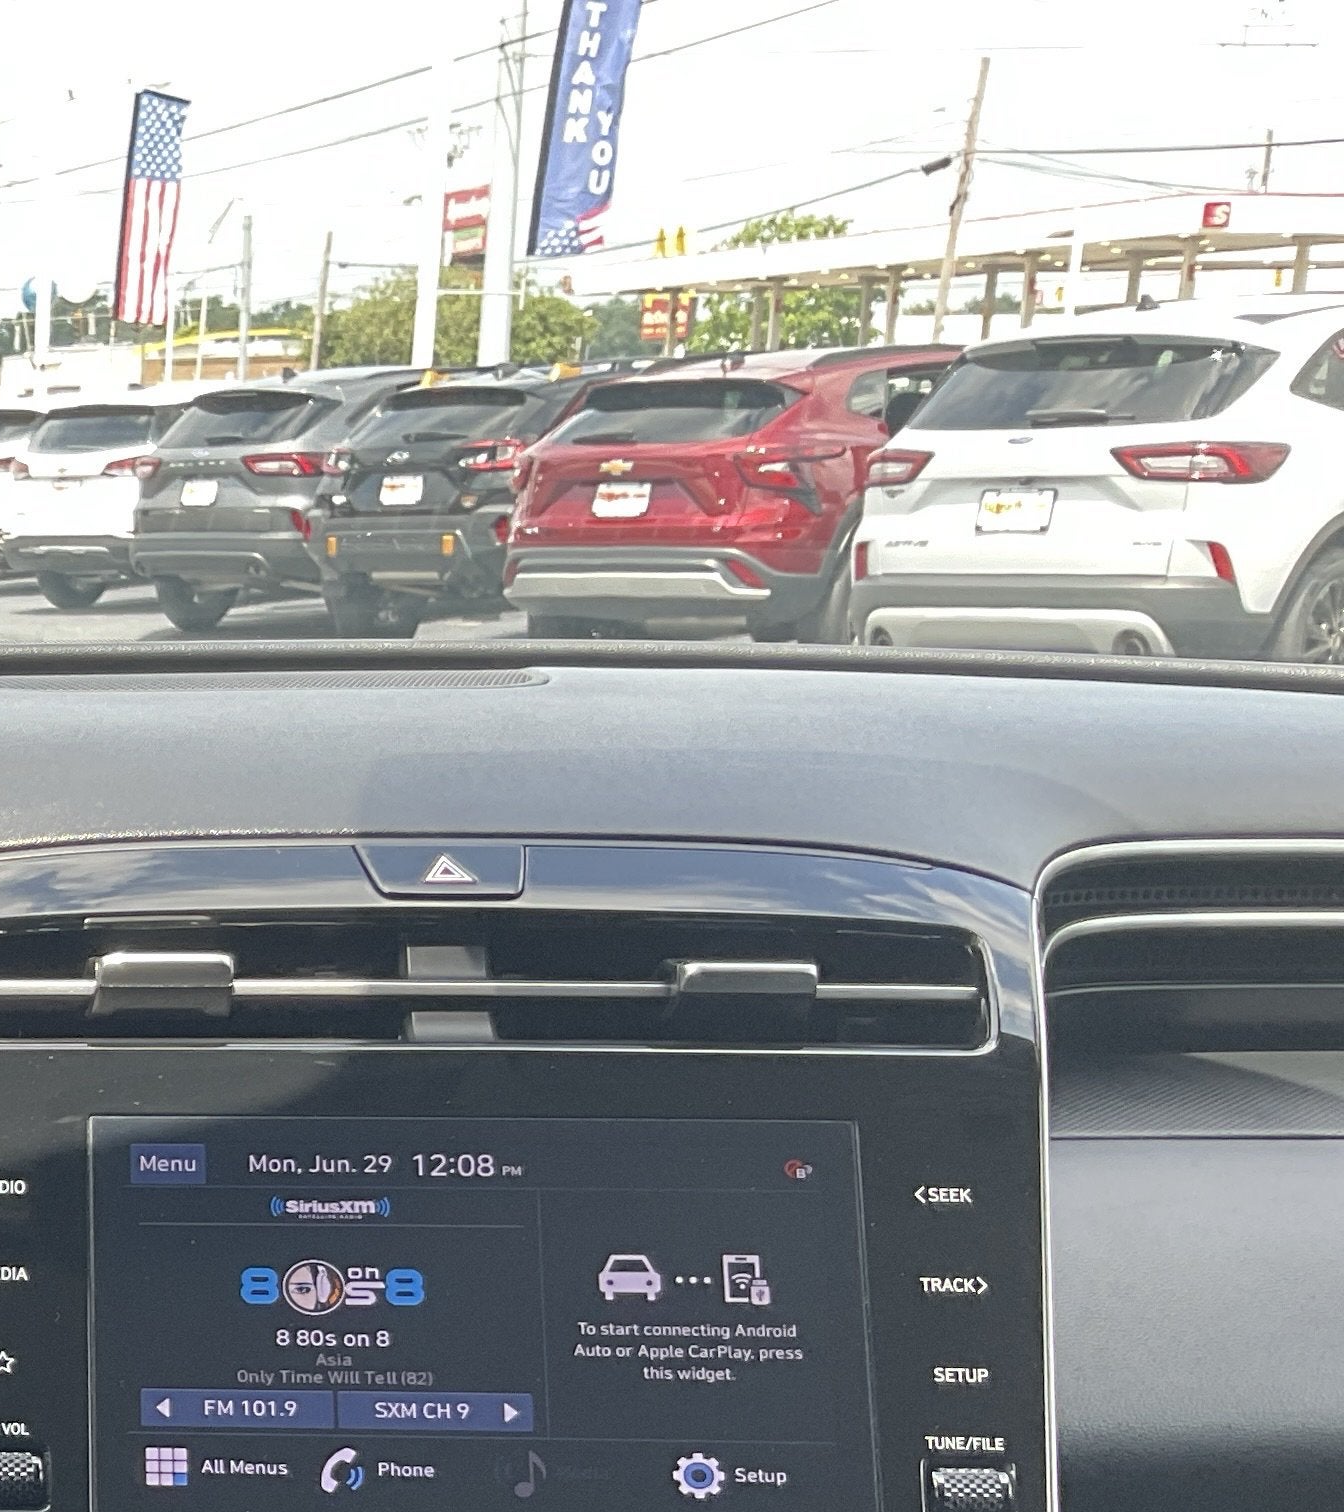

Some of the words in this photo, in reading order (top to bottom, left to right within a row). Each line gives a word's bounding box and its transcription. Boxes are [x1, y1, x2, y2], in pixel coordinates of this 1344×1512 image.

[563, 1, 608, 144] THANK
[588, 109, 614, 196] YOU
[139, 1154, 197, 1173] Menu
[247, 1153, 303, 1175] Mon,
[309, 1154, 358, 1173] Jun.
[362, 1154, 393, 1174] 29
[411, 1153, 495, 1177] 12:08
[501, 1165, 523, 1178] PM
[275, 1329, 291, 1347] 8
[295, 1329, 337, 1348] 80s
[342, 1334, 370, 1348] on
[376, 1331, 390, 1348] 8
[577, 1321, 596, 1337] To
[599, 1322, 641, 1337] start
[643, 1323, 731, 1341] connecting
[734, 1323, 798, 1339] Android
[315, 1353, 353, 1368] Asia
[573, 1343, 612, 1358] Auto
[615, 1346, 634, 1359] or
[637, 1344, 685, 1361] Apple
[758, 1347, 804, 1362] press
[236, 1369, 275, 1386] Only
[278, 1370, 325, 1385] Time
[327, 1370, 360, 1386] Will
[364, 1371, 397, 1386] Tell
[400, 1371, 434, 1387] (82)
[642, 1365, 674, 1381] this
[932, 1367, 990, 1384] SETUP
[203, 1400, 234, 1417] FM
[240, 1400, 298, 1418] 101.9
[374, 1402, 417, 1420] SXM
[422, 1403, 452, 1420] CH
[455, 1403, 470, 1420] 9
[924, 1435, 1006, 1452] TUNE/FILE
[200, 1459, 226, 1475] All
[230, 1460, 289, 1476] Menus
[377, 1461, 436, 1478] Phone
[733, 1467, 788, 1488] Setup
